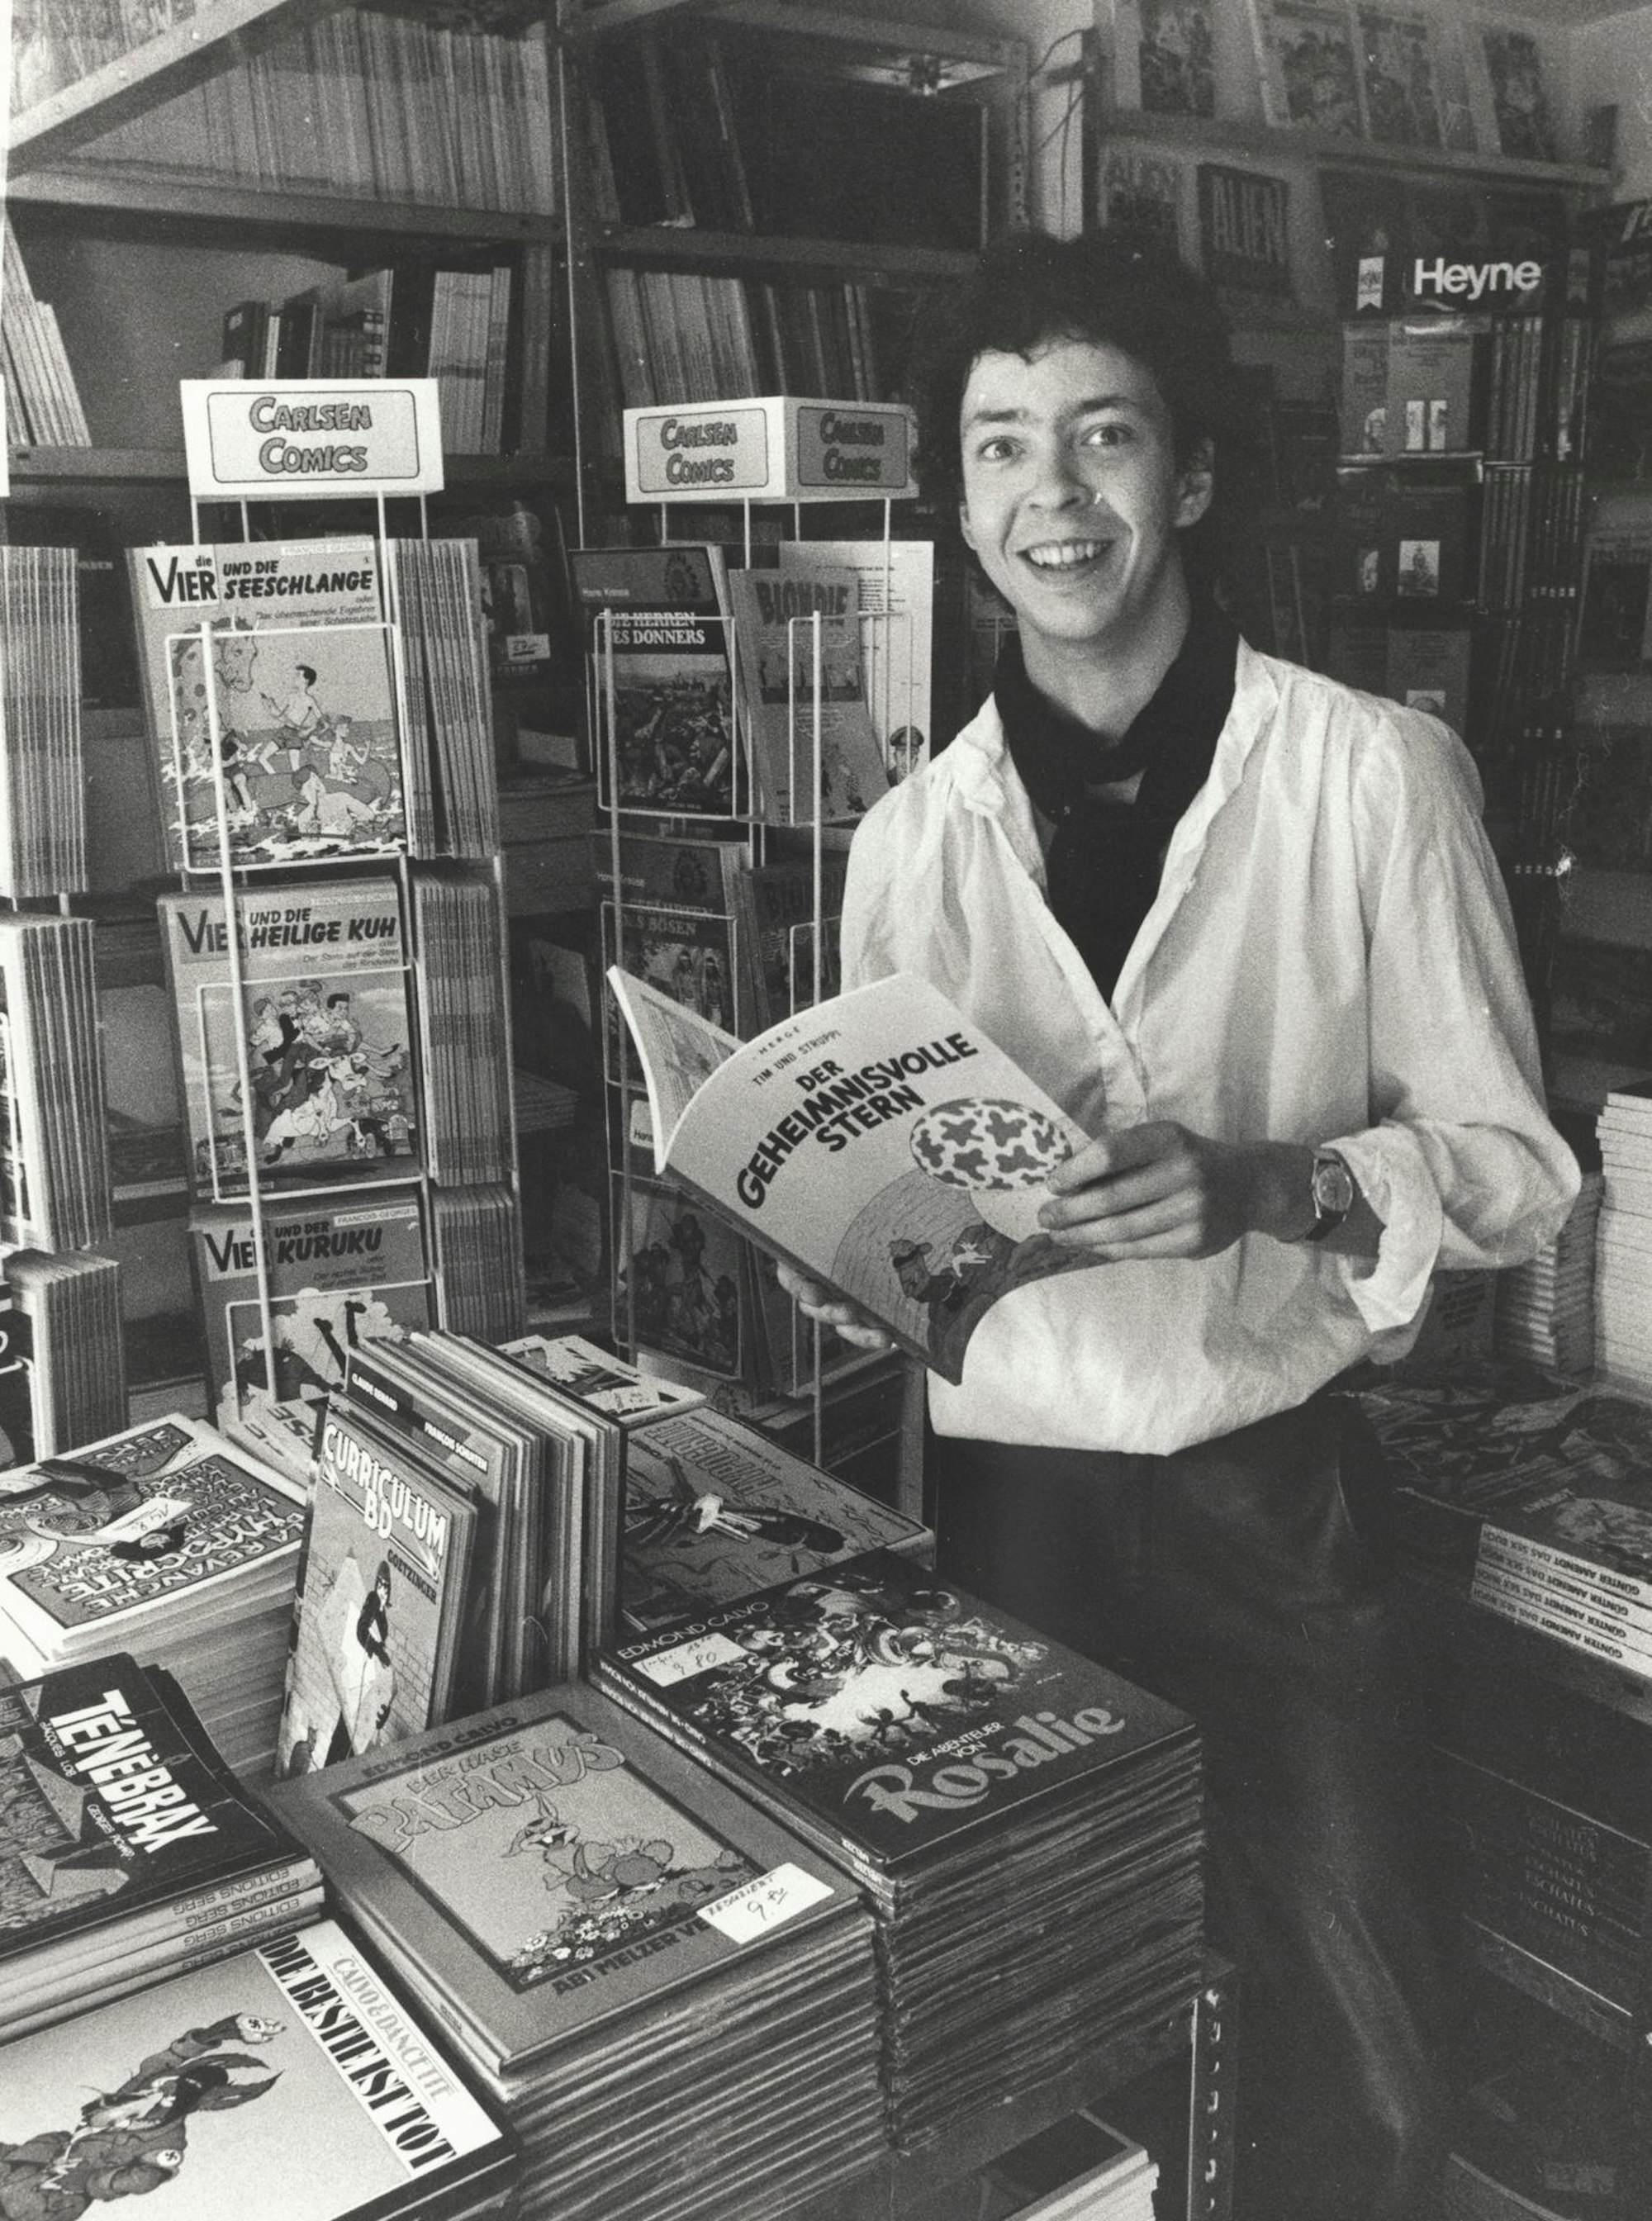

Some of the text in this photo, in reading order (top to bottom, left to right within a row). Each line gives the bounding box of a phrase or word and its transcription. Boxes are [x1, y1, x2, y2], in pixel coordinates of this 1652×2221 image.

[1414, 257, 1541, 300] Heyne
[249, 396, 372, 433] CARLSEN
[819, 412, 885, 445] CARLSEN
[661, 419, 738, 450] CARLSEN
[259, 437, 368, 474] COMICS
[666, 453, 735, 485] COMICS
[824, 448, 881, 481] COMICS
[195, 555, 212, 567] die
[223, 560, 278, 577] UND DIE
[146, 557, 216, 603] VIER
[224, 570, 373, 600] SEESCHLANGE
[633, 612, 695, 627] HERREN
[633, 629, 705, 644] DONNERS
[249, 908, 312, 926] UND DIE
[250, 917, 396, 949] HEILIGE KUH
[752, 1029, 843, 1087] TIM UND STRUPPI
[795, 1059, 845, 1094] DER
[737, 1032, 979, 1210] GEHEIMNISVOLLE
[815, 1083, 926, 1153] STERN
[276, 1221, 330, 1238] UND DER
[278, 1227, 382, 1265] KURUKU
[325, 1422, 448, 1557] CURRICULUM
[364, 1489, 393, 1540] BD
[1555, 1557, 1597, 1579] AMENDT
[1599, 1573, 1640, 1596] GÜNTER
[1546, 1576, 1588, 1598] AMENDT
[1545, 1597, 1585, 1621] AMENDT
[1590, 1593, 1629, 1616] GÜNTER
[618, 1623, 707, 1660] EDMOND
[707, 1601, 769, 1629] CALVO
[1540, 1617, 1582, 1641] AMENDT
[1588, 1615, 1626, 1639] GÜNTER
[1583, 1635, 1623, 1659] GÜNTER
[906, 1721, 1006, 1767] DIE ABENTEUER
[951, 1740, 988, 1760] VON
[843, 1707, 1126, 1824] Rosalie
[173, 1867, 290, 1915] EDITIONS SERG
[186, 1878, 300, 1928] EDITIONS SERG
[230, 1898, 300, 1931] EDITIONS
[183, 1924, 227, 1948] SERG
[597, 1930, 680, 1977] MELZER
[259, 1935, 458, 2171] DIE BESTIE IST TOT
